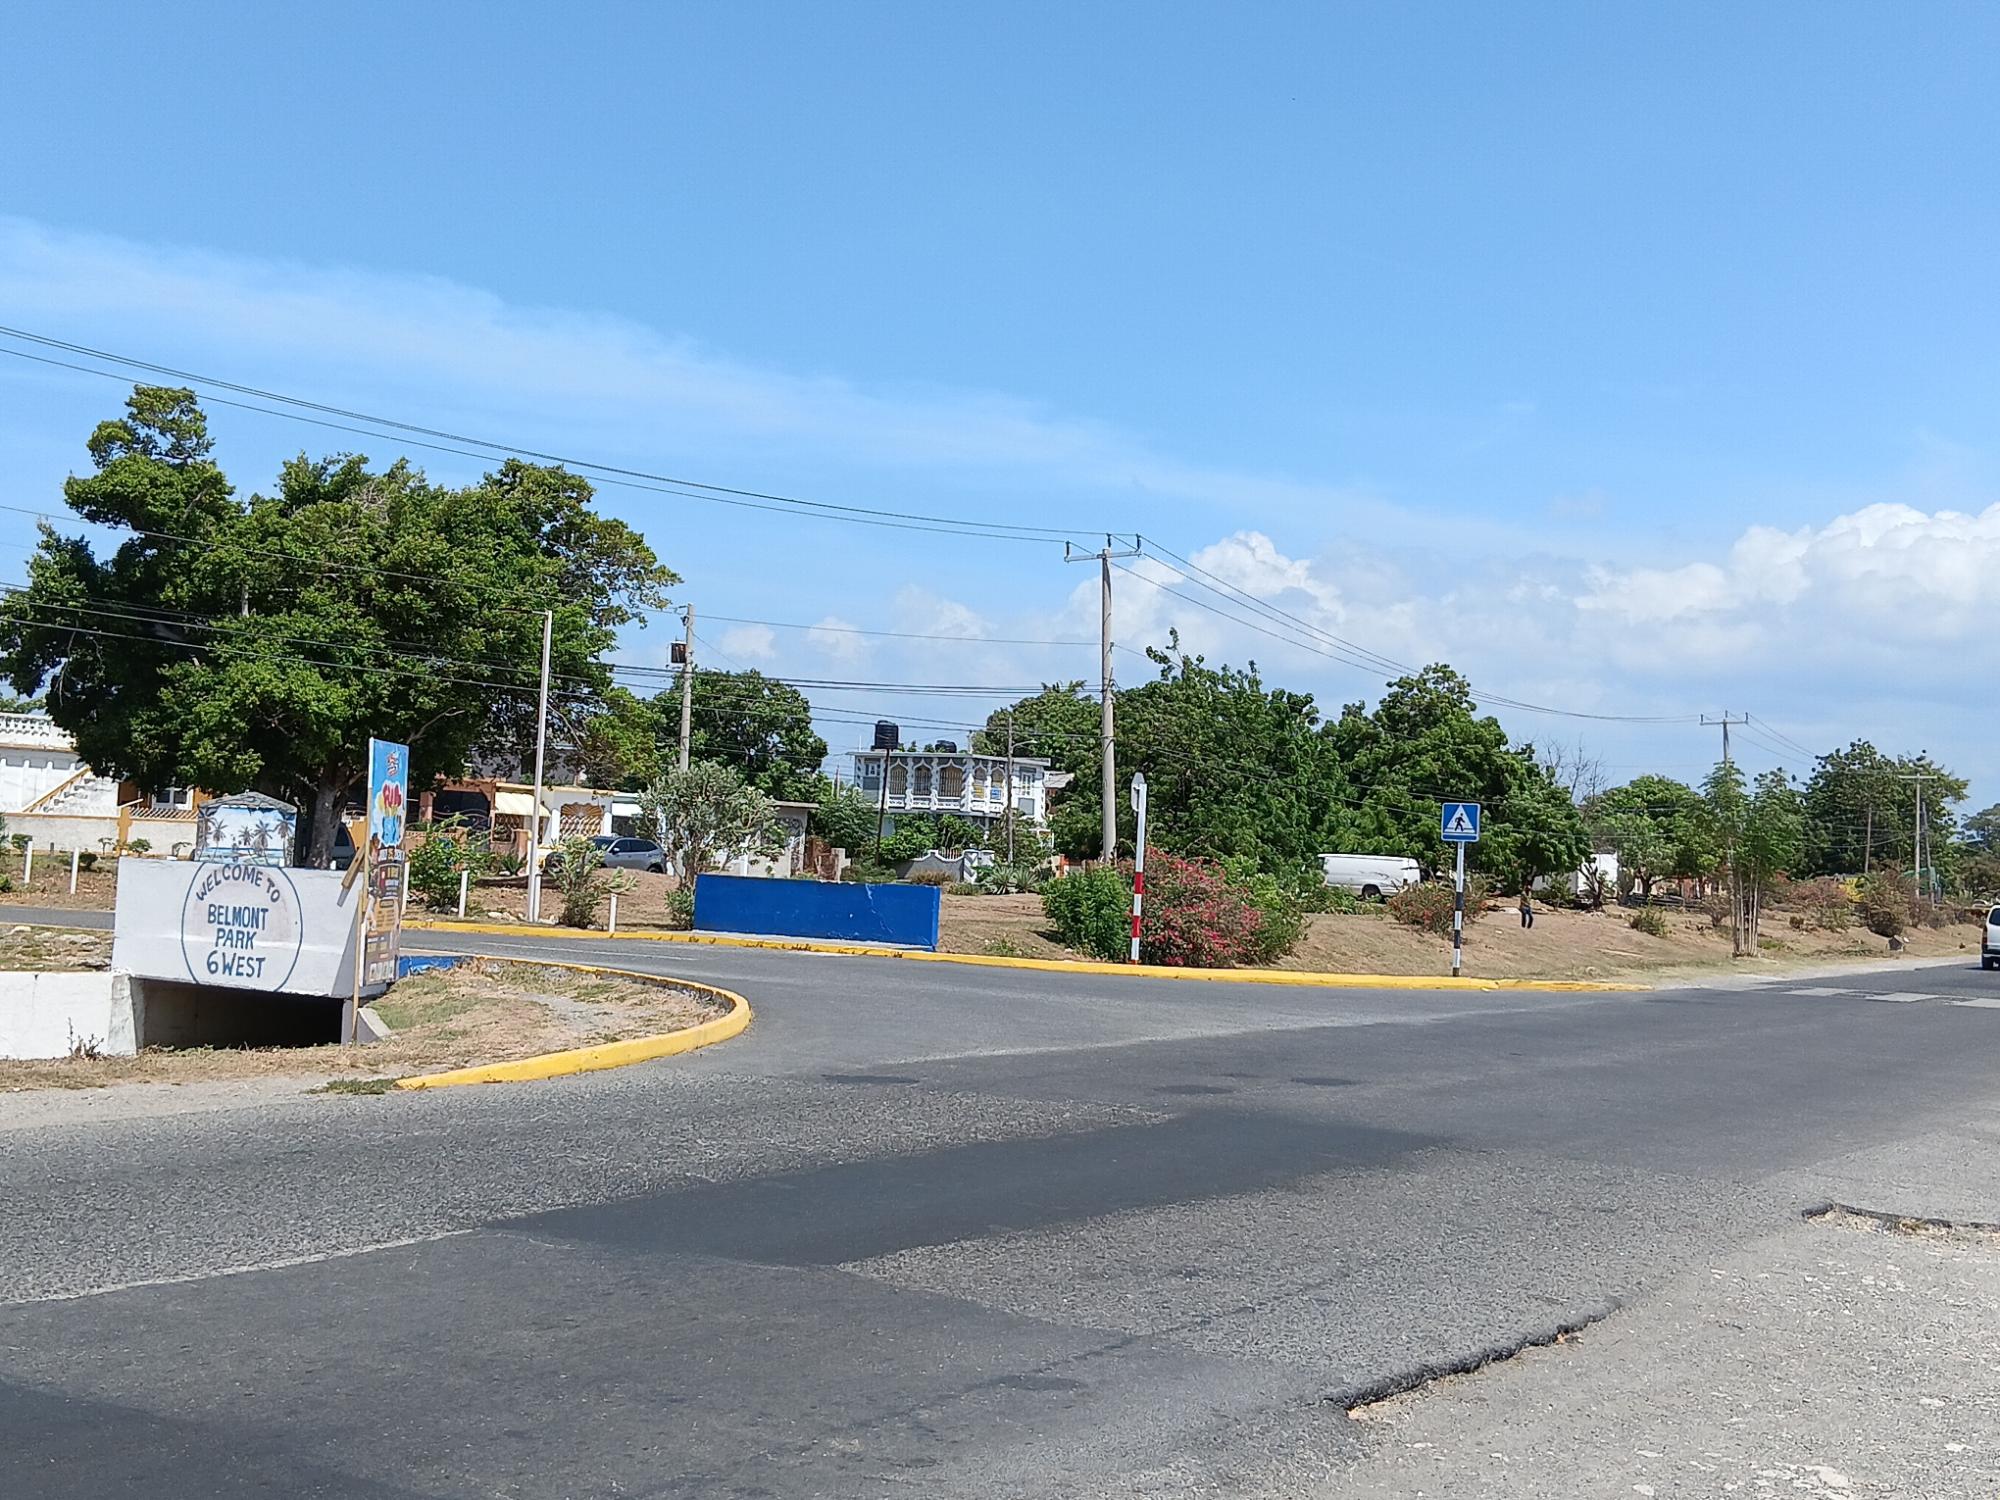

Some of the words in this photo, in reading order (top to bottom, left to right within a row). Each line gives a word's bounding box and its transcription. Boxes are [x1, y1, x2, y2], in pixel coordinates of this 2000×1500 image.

[196, 864, 264, 901] WELCOME
[266, 877, 281, 903] TO
[208, 903, 269, 931] BELMONT
[215, 928, 257, 950] PARK
[222, 952, 266, 978] WEST
